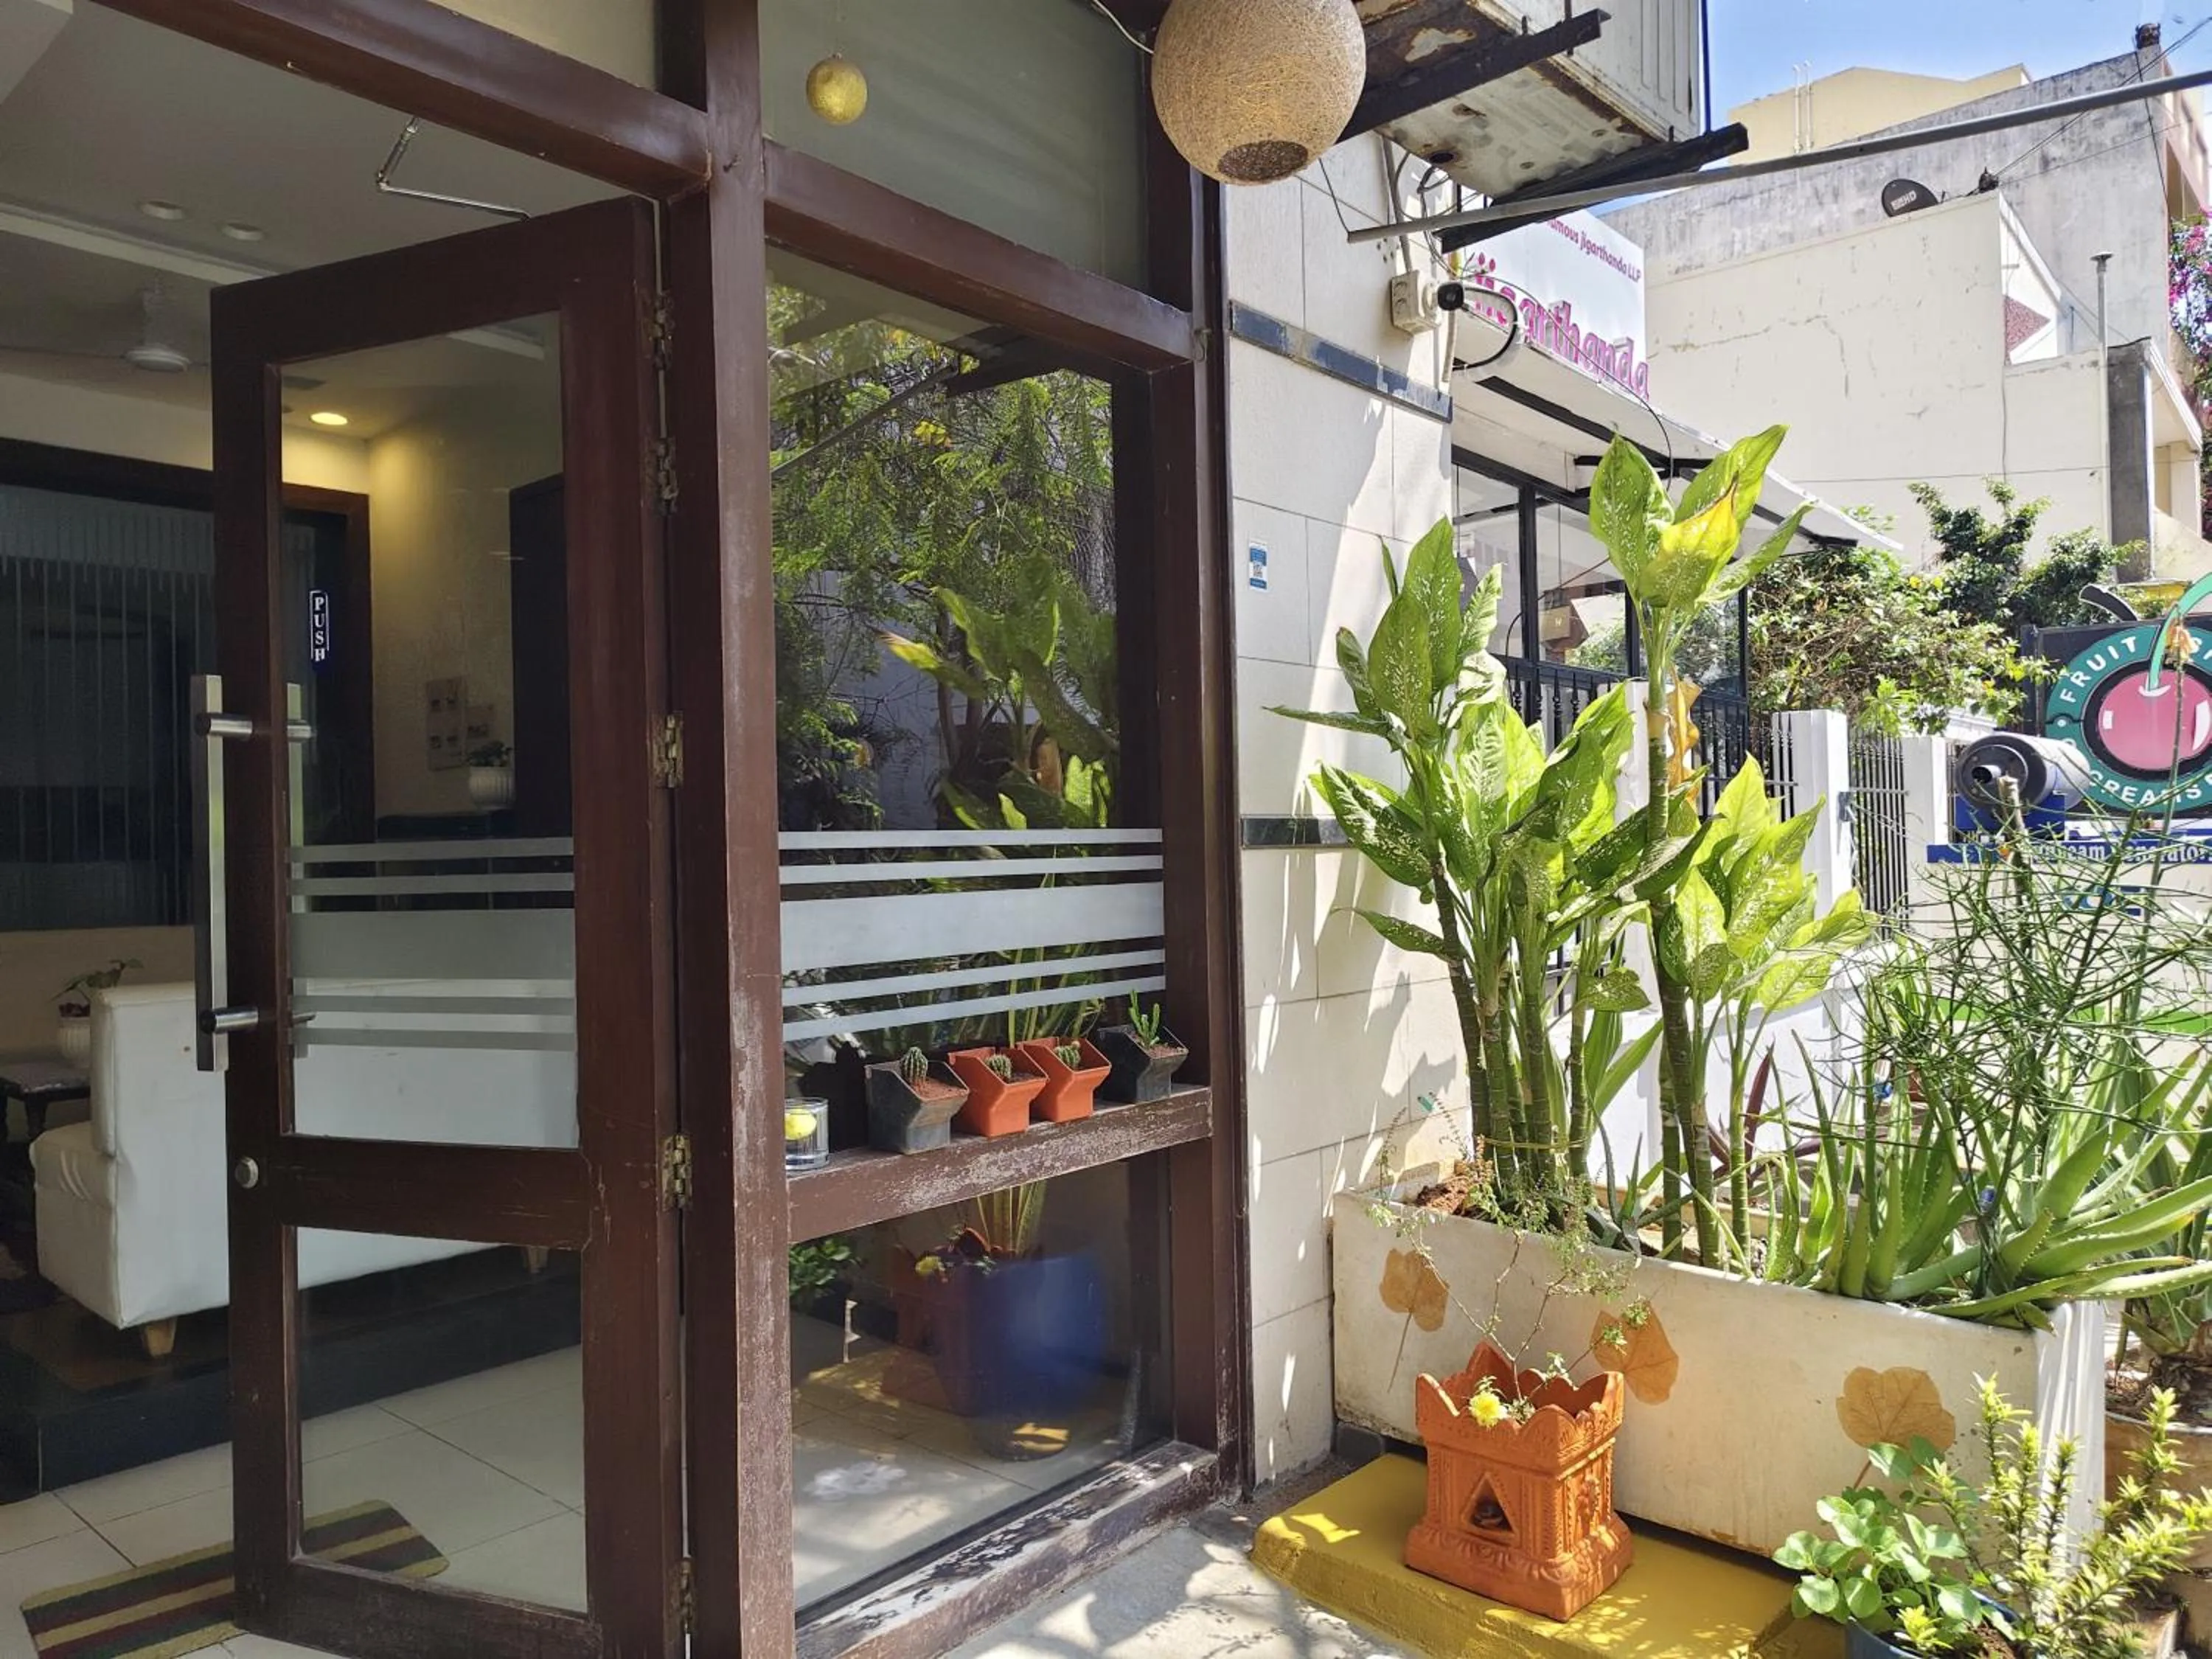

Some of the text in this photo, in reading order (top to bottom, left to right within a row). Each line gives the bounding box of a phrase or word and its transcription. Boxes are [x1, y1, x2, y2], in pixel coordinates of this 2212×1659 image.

[1547, 219, 1579, 244] amous
[1627, 263, 1641, 283] LLP
[314, 596, 325, 662] PUSH
[2059, 636, 2137, 703] FRUIT
